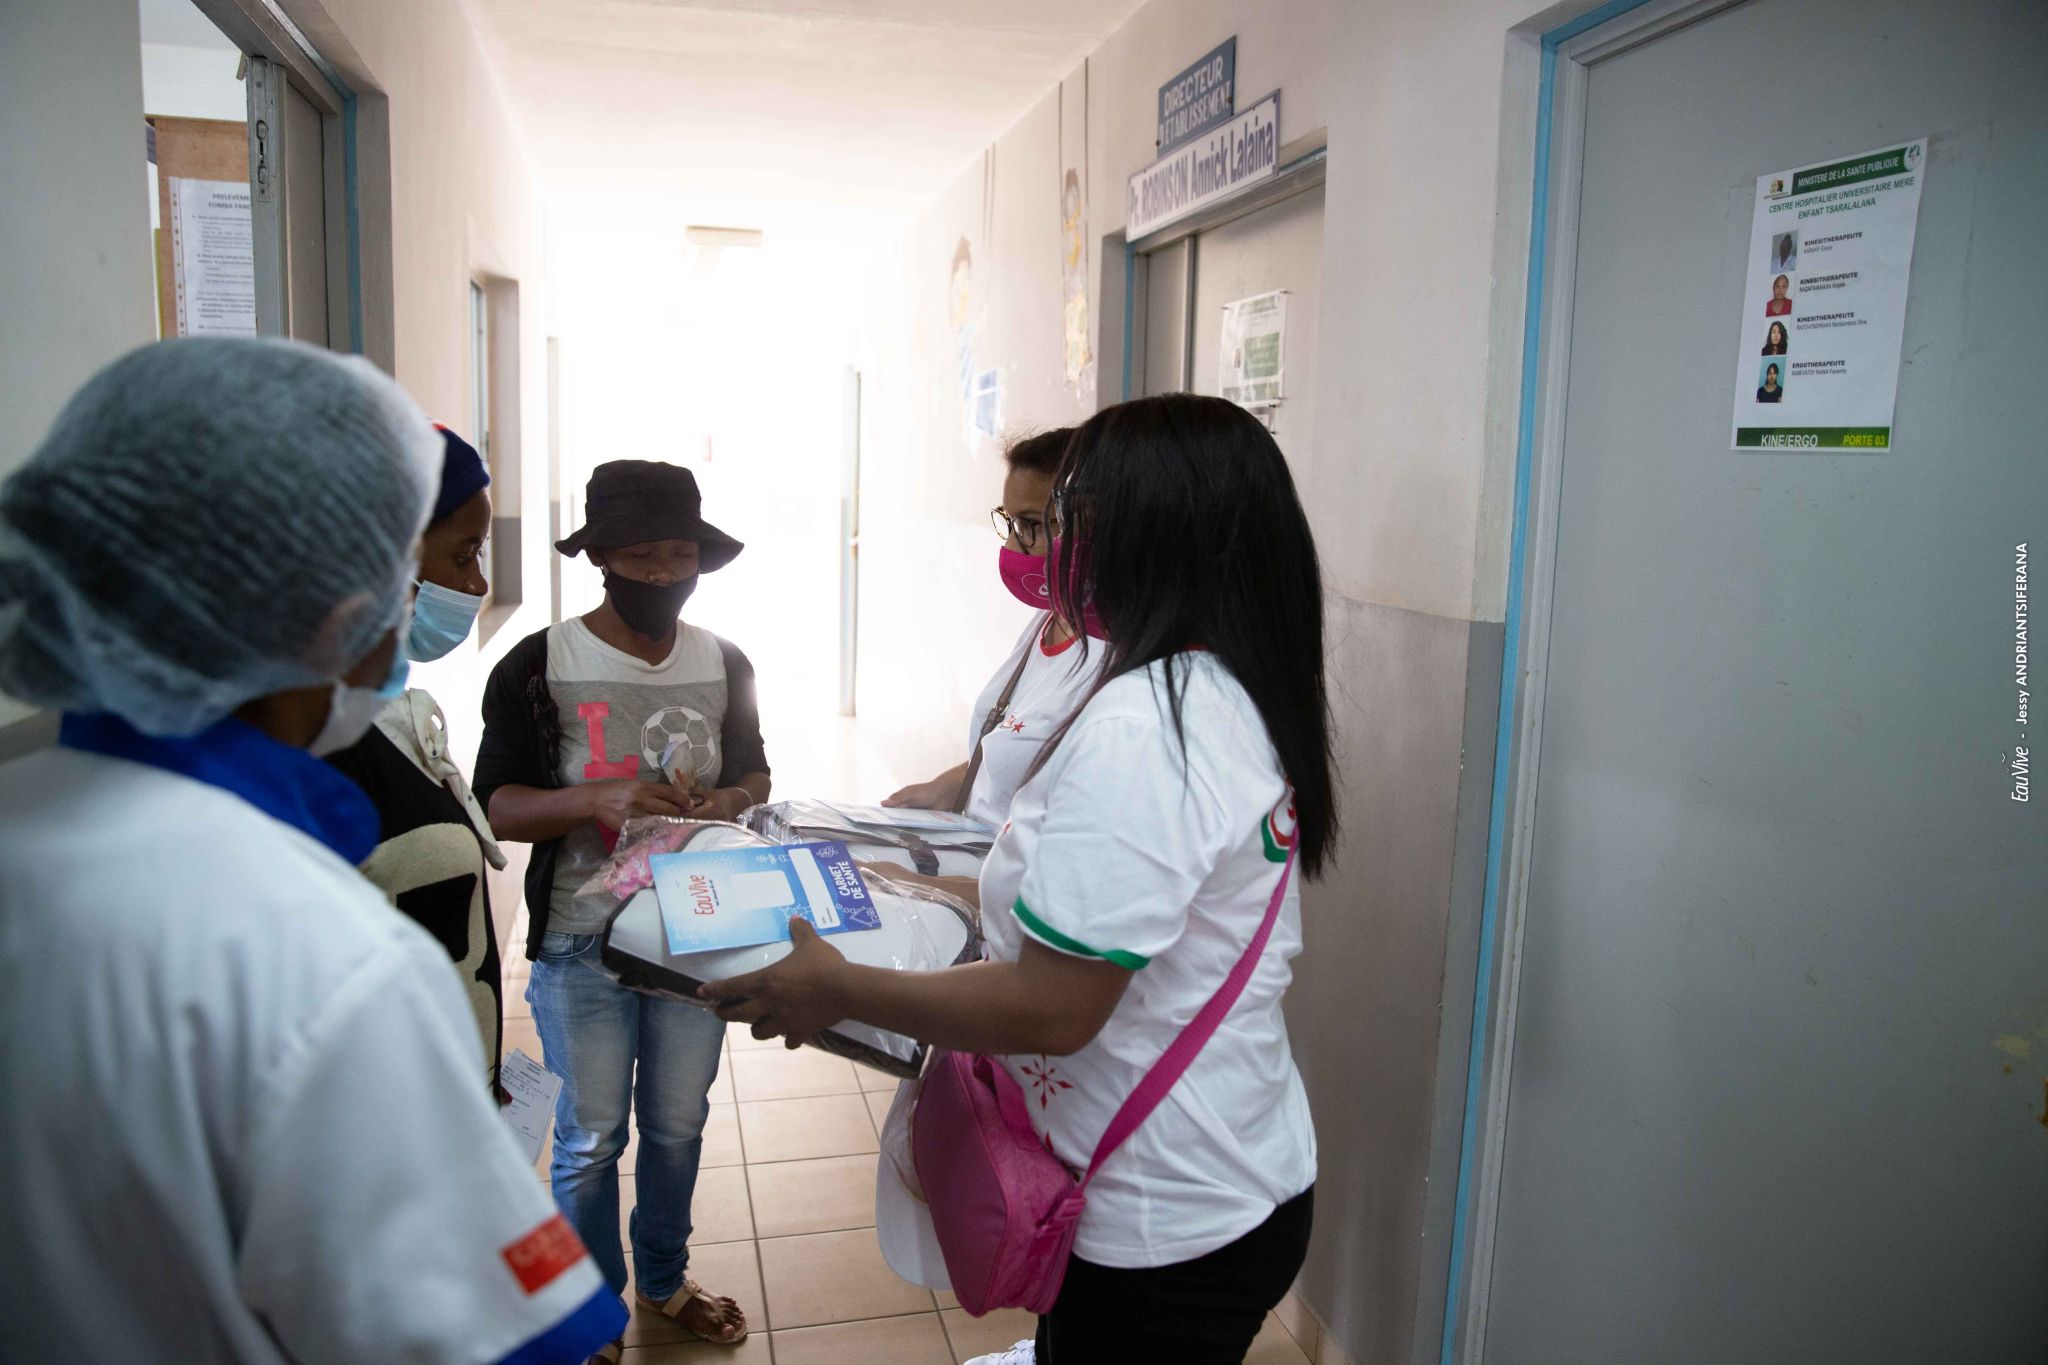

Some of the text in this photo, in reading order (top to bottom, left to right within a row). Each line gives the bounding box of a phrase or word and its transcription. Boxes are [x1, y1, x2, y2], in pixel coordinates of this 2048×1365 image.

[1164, 55, 1223, 116] DIRECTEUR
[1191, 135, 1229, 200] Annick
[1230, 115, 1273, 183] Lalaina
[1828, 170, 1837, 181] DE
[1837, 168, 1846, 179] LA
[1867, 156, 1899, 173] PUBLIQUE
[1769, 201, 1794, 214] CENTRE
[1794, 193, 1838, 208] HOSPITALIER
[1838, 181, 1893, 199] UNIVERSITAIRE
[1798, 207, 1824, 219] ENFANT
[1792, 360, 1846, 369] ERGOTHERAPEUTE
[1760, 434, 1819, 448] KINE/ERGO
[1842, 434, 1886, 446] PORTE 03
[828, 865, 851, 896] CARNET
[835, 860, 865, 899] DE SANTÉ
